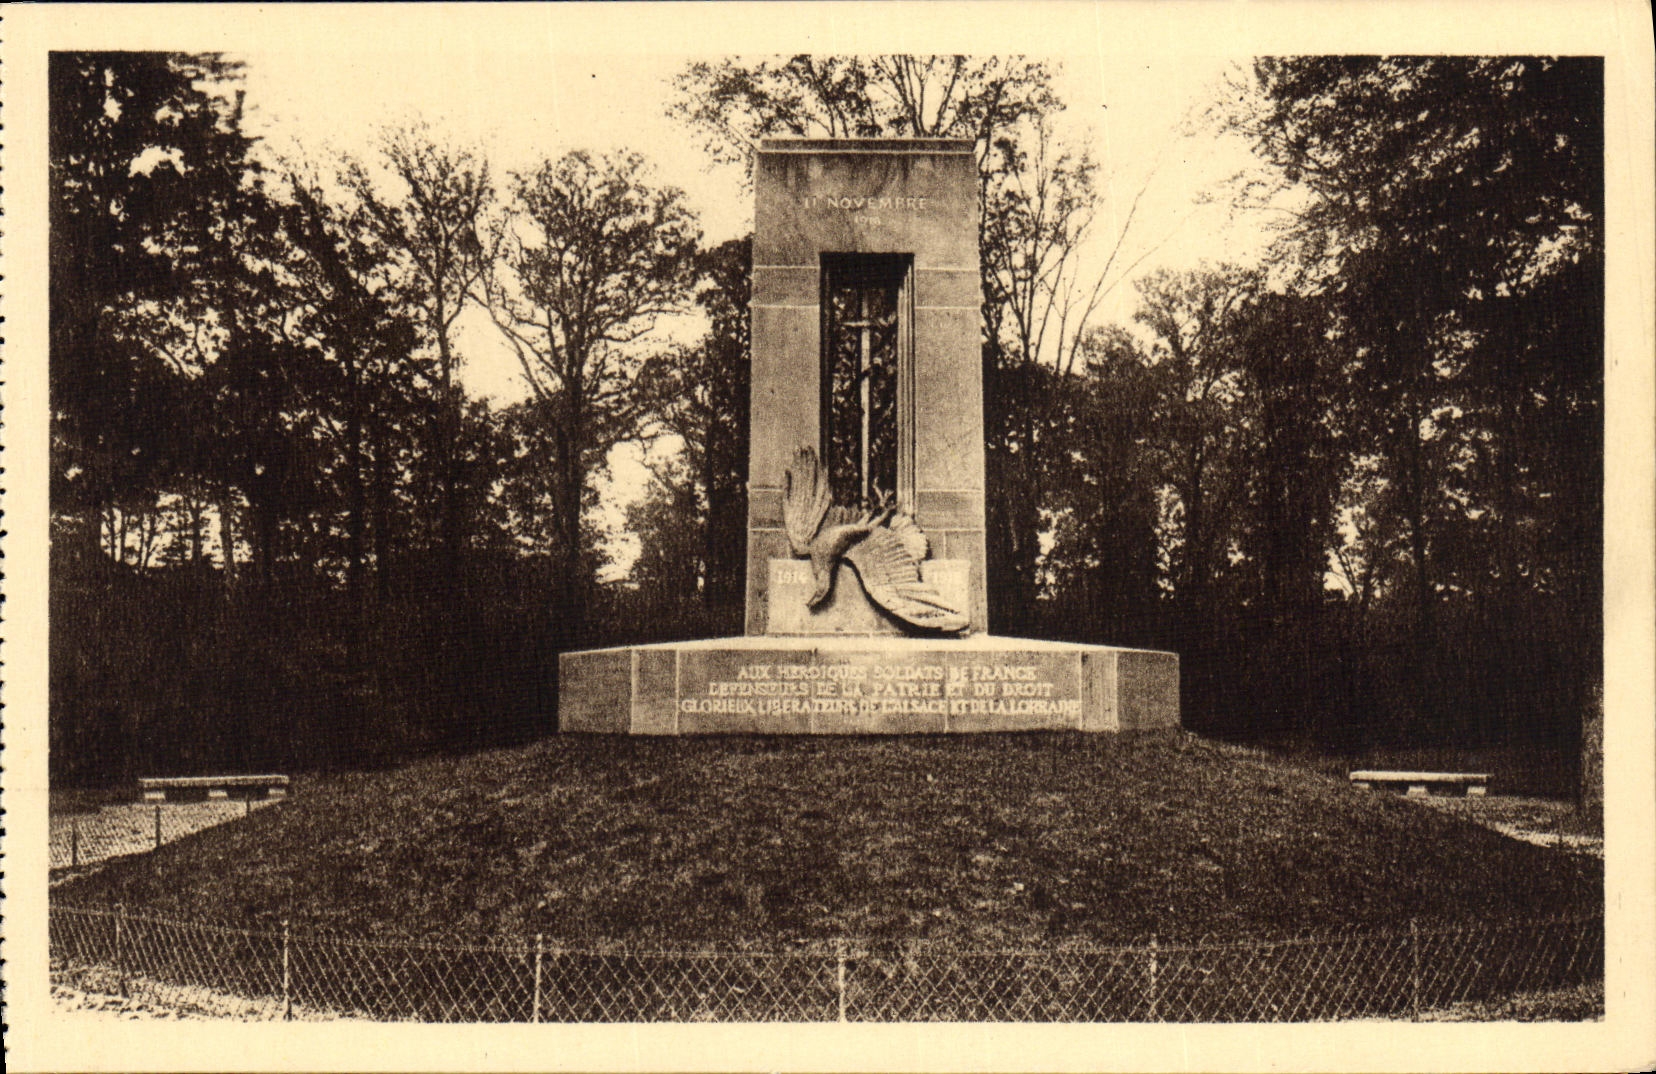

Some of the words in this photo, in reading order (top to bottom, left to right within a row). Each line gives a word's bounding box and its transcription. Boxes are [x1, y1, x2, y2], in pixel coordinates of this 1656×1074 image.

[827, 197, 927, 209] NOVEMBRE
[777, 570, 808, 585] 1914
[737, 665, 771, 679] AUX
[873, 665, 943, 680] SOLDATS
[949, 665, 968, 681] DE
[971, 665, 1037, 680] FRANCE
[709, 682, 808, 696] DEFENSEURS
[816, 682, 838, 696] DE
[842, 682, 863, 696] LA
[872, 682, 940, 696] PATRIE
[946, 682, 965, 696] ET
[974, 682, 996, 696] DU
[1002, 682, 1054, 696] DROIT
[681, 699, 756, 714] GLORIEUX
[859, 700, 881, 714] DE
[950, 700, 968, 714] ET
[971, 700, 989, 714] DE
[989, 700, 1007, 714] LA
[1010, 700, 1081, 715] LORRAINE
